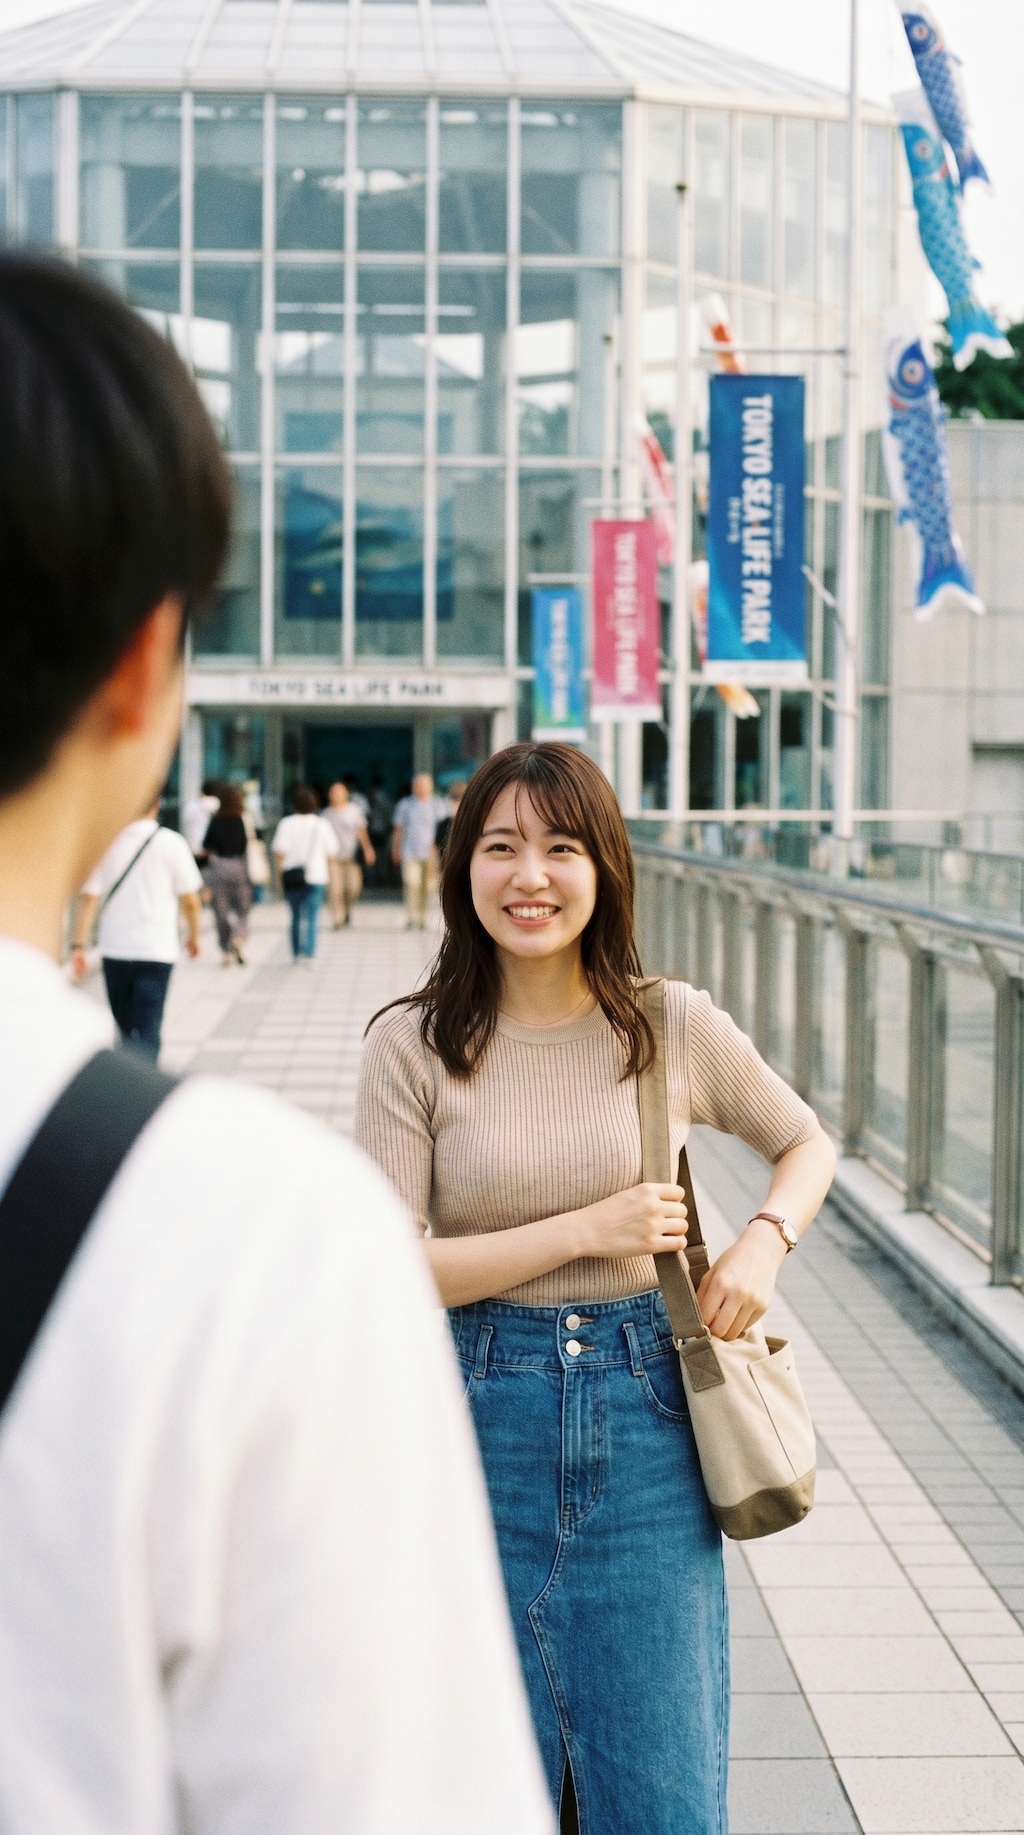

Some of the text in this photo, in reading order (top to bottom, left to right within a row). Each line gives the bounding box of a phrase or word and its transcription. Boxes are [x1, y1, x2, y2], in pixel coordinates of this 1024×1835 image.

[742, 394, 773, 474] TOKYO
[741, 579, 771, 643] PARK
[249, 680, 443, 696] TOKYO SEA LIFE PARK
